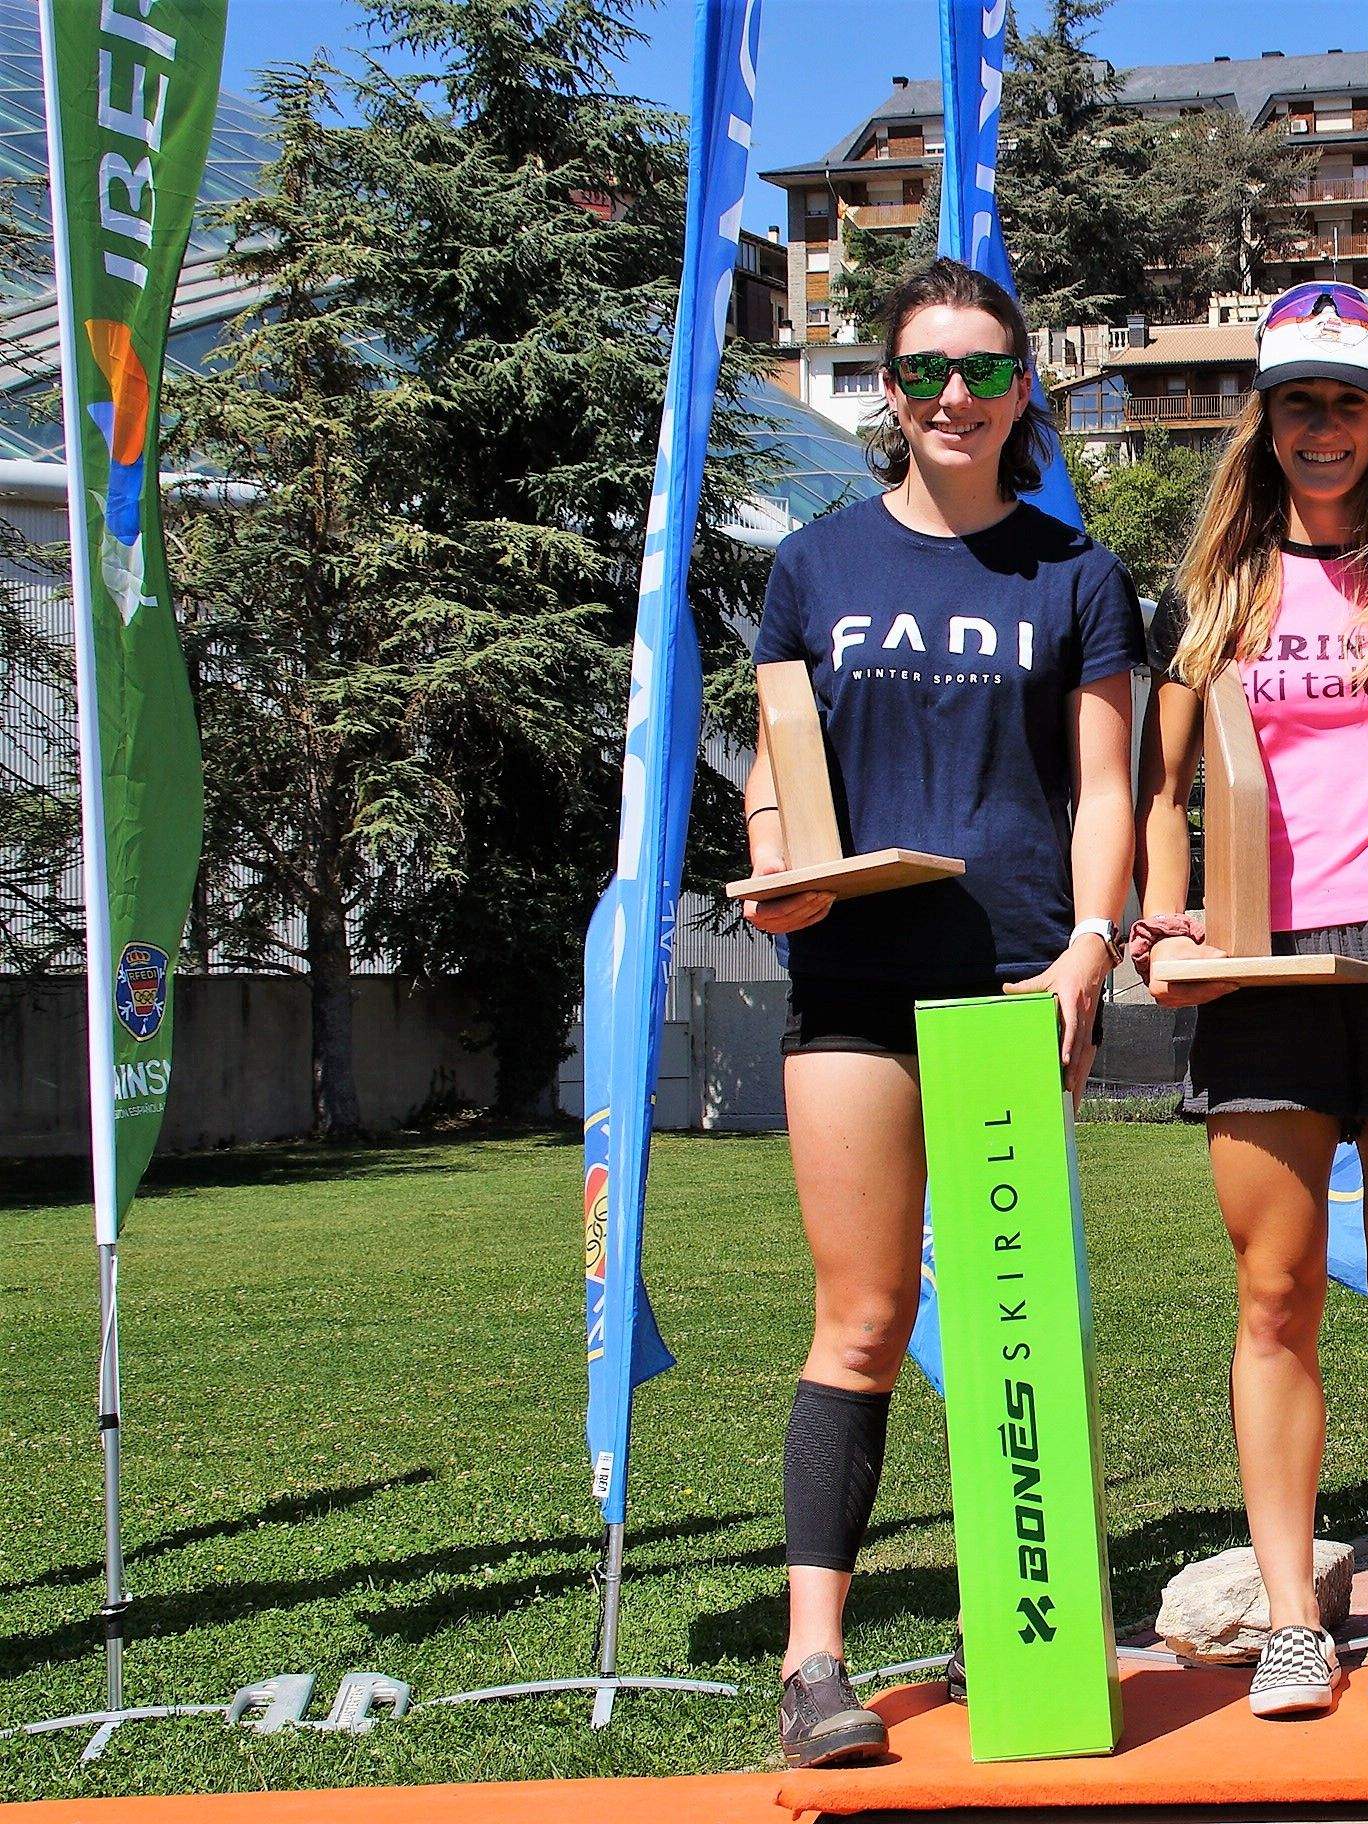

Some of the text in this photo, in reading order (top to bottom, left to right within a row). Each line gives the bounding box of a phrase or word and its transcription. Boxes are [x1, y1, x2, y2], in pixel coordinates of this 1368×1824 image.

[831, 613, 1034, 673] FADI
[852, 667, 1003, 685] WINTER SPORTS
[984, 1108, 1051, 1585] BONES SKIROLL
